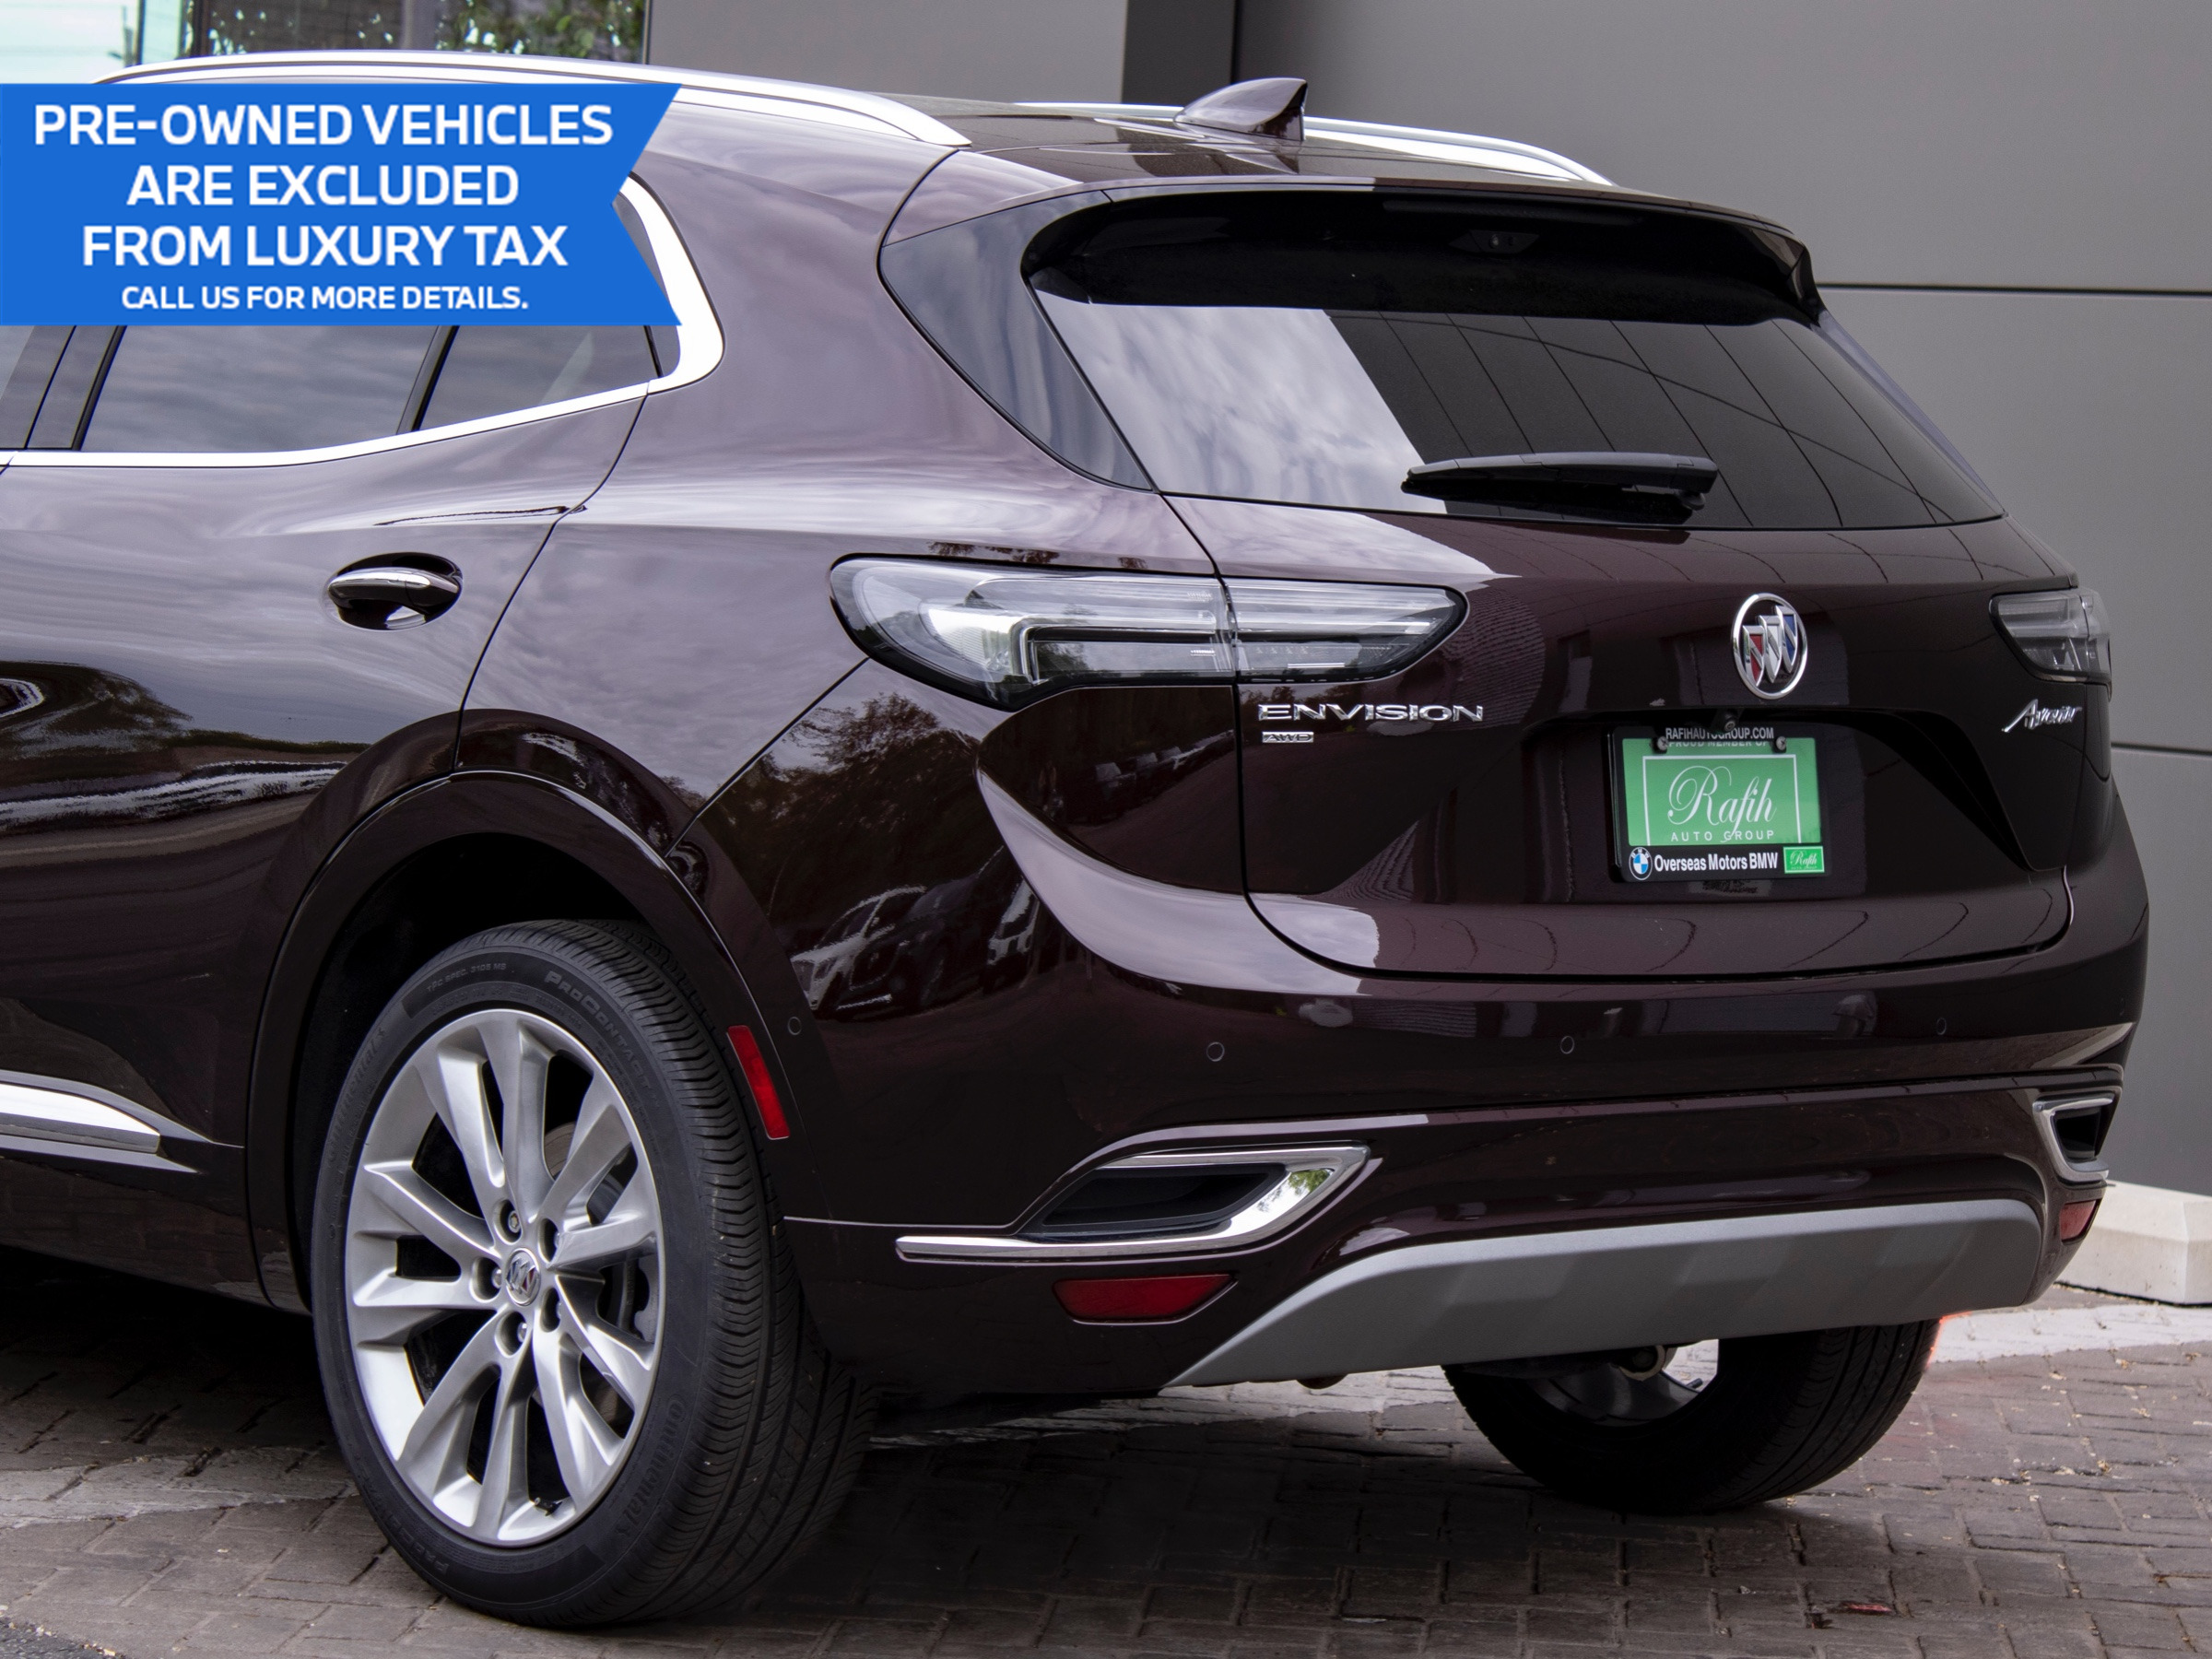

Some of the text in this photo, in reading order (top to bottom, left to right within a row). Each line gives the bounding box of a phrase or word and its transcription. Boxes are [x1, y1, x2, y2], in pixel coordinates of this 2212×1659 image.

[1257, 703, 1484, 723] ENVISION
[1263, 732, 1313, 743] AWD
[1667, 765, 1777, 843] Rafih
[1670, 830, 1775, 842] AUTO GROUP
[1653, 852, 1779, 872] Overseas Motors BMW
